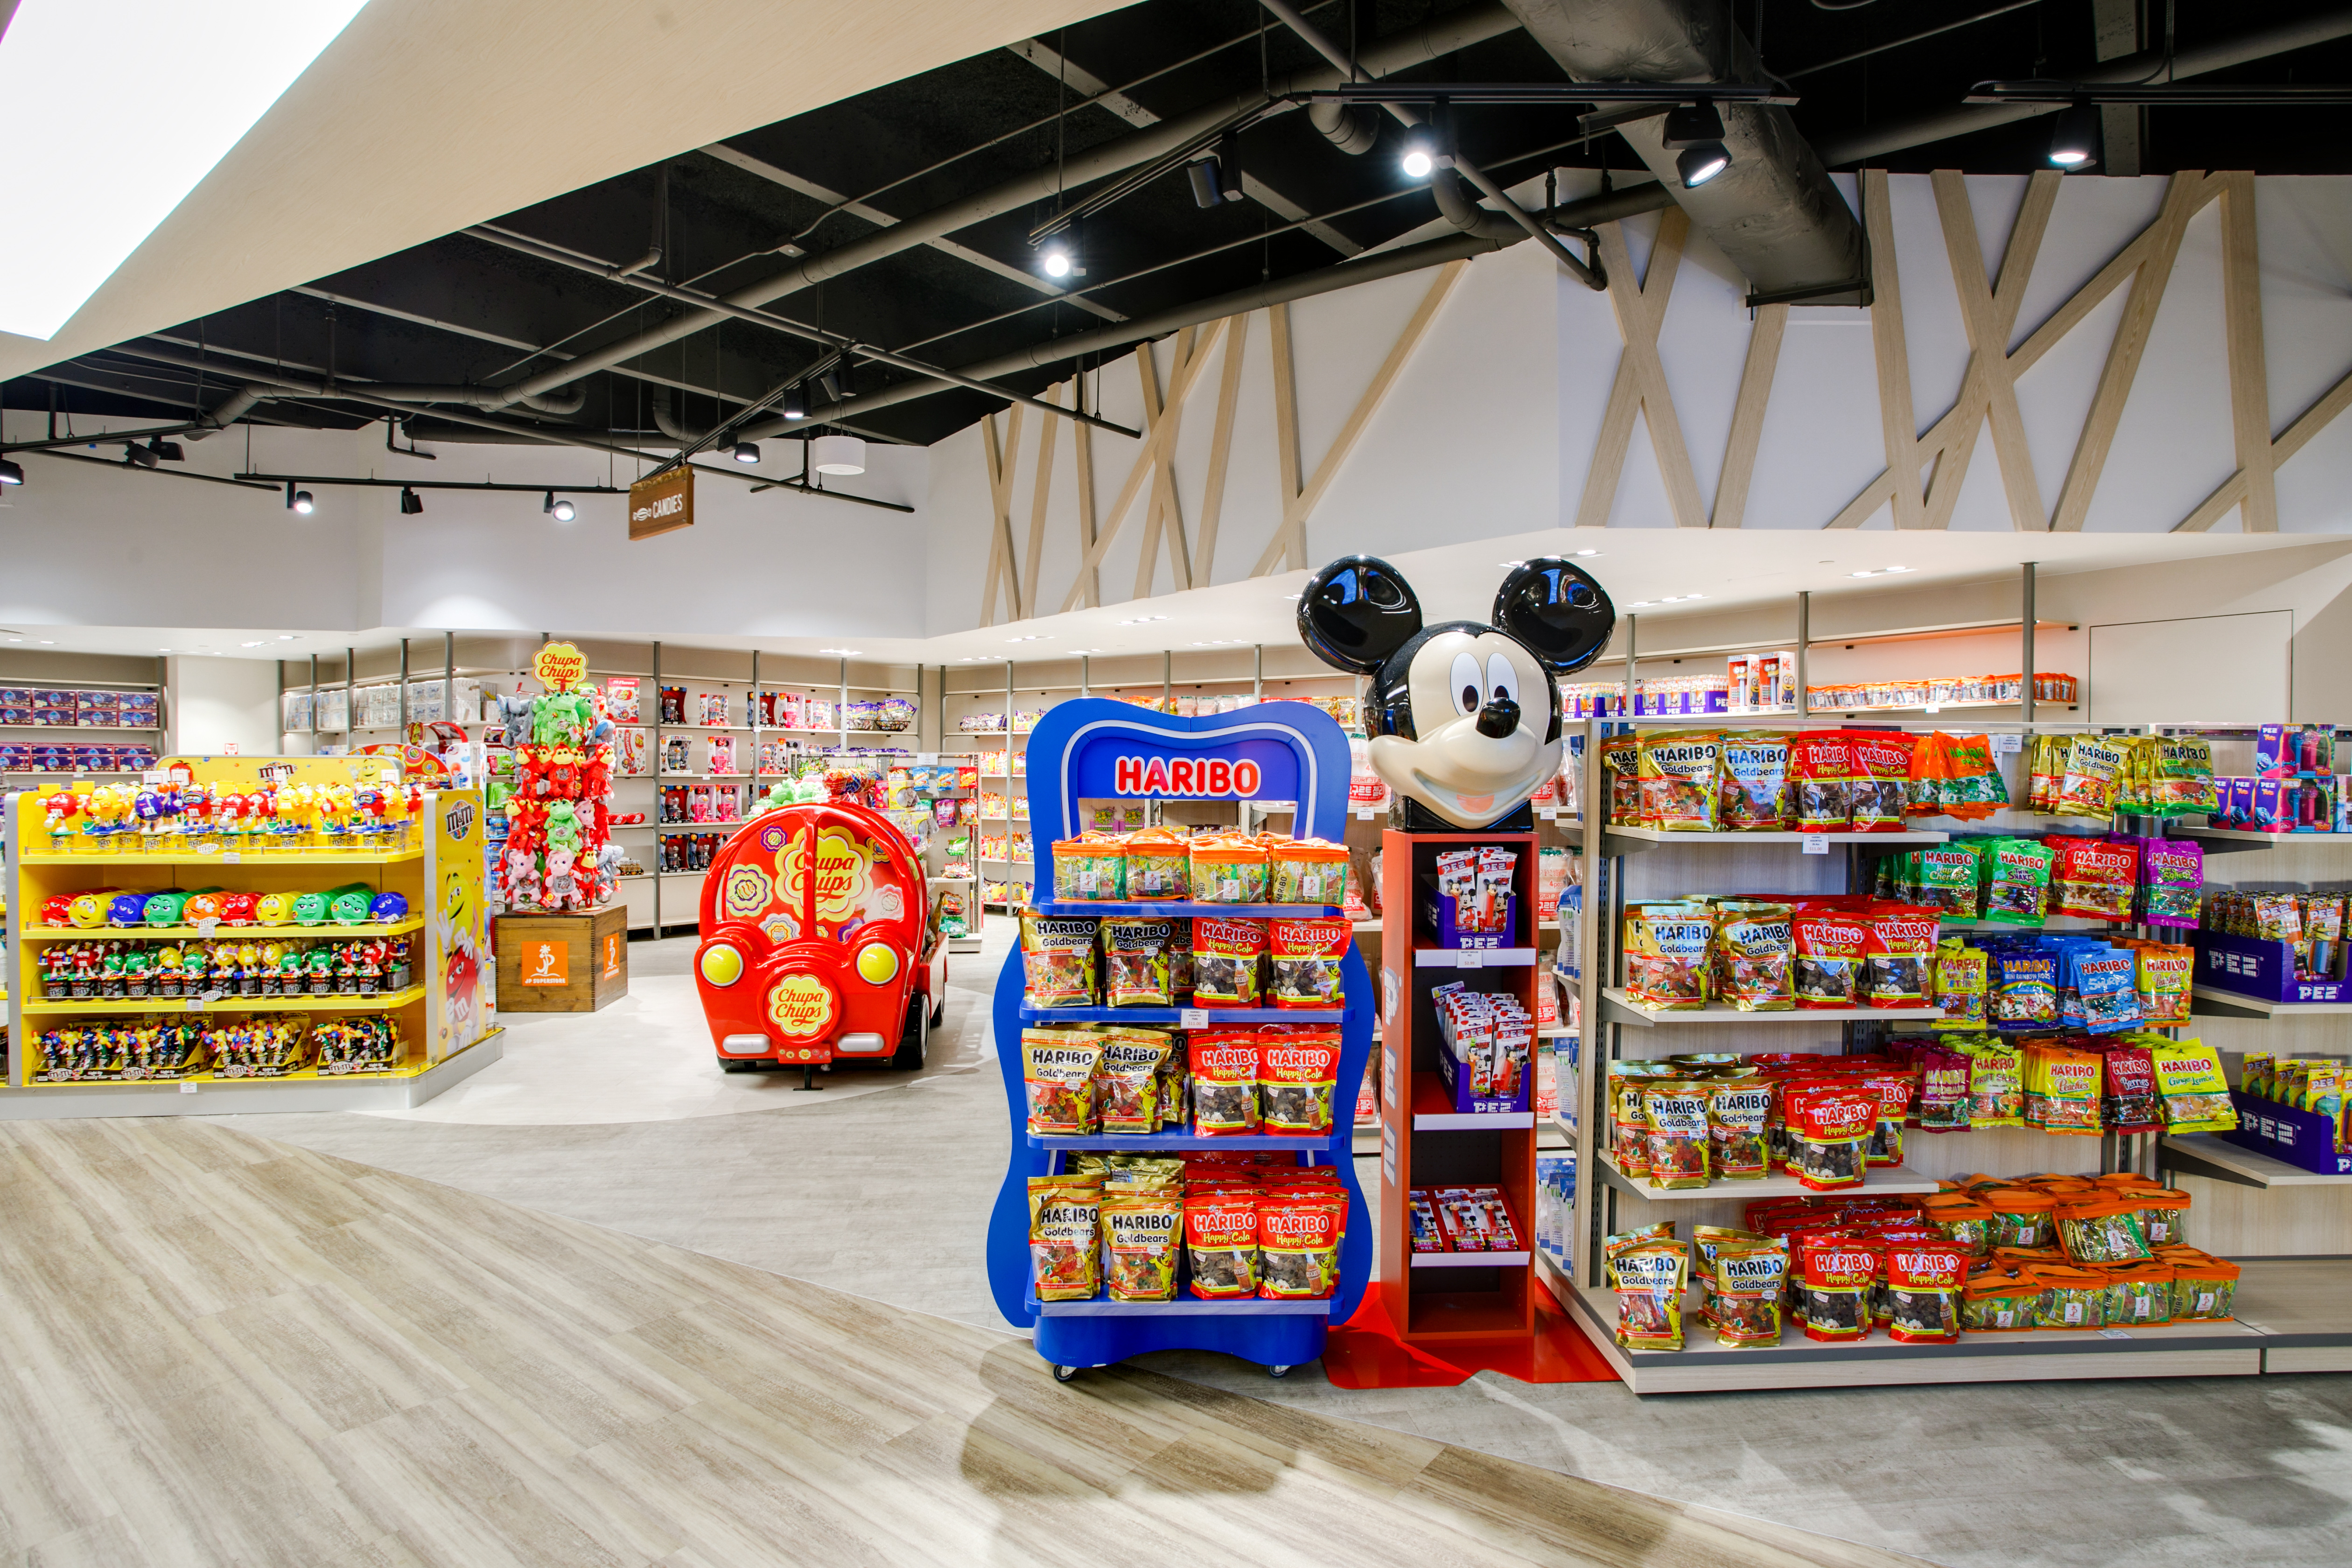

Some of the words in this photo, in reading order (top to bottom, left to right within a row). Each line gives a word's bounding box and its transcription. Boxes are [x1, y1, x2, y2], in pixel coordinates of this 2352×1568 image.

[652, 493, 683, 518] CANDIES
[542, 653, 581, 668] Chupa
[1782, 660, 1791, 670] ME
[539, 665, 580, 685] Chups
[1653, 744, 1717, 762] HARIBO
[1726, 748, 1788, 765] HARIBO
[1857, 746, 1908, 765] HARIBO
[2077, 743, 2120, 764] HARIBO
[1661, 764, 1714, 773] Goldbears
[1733, 767, 1785, 777] Goldbears
[2079, 758, 2116, 774] Goldbears
[1115, 756, 1261, 797] HARIBO
[794, 852, 856, 875] Cupa
[1925, 851, 1973, 866] HARIBO
[1999, 852, 2045, 870] HARIBO
[2073, 851, 2131, 868] HARIBO
[2151, 852, 2198, 870] HARIBO
[1483, 862, 1506, 872] PEZ
[2076, 865, 2103, 877] Happy
[2106, 868, 2126, 878] Cola
[791, 872, 853, 903] Cups
[2259, 902, 2292, 919] PEZ
[2309, 907, 2336, 920] PEZ
[1036, 921, 1097, 935] HARIBO
[1111, 924, 1170, 939] HARIBO
[1201, 922, 1261, 943] HARIBO
[1280, 926, 1340, 942] HARIBO
[1654, 924, 1712, 942] HARIBO
[1802, 924, 1862, 944] HARIBO
[1875, 922, 1932, 938] HARIBO
[1043, 937, 1092, 947] Goldbears
[1116, 939, 1164, 950] Goldbears
[1460, 935, 1500, 949] PEZ
[1659, 944, 1707, 954] Goldbears
[1745, 943, 1789, 956] Goldbear
[2003, 959, 2051, 973] HARIBO
[2080, 959, 2131, 974] HARIBO
[2209, 948, 2260, 977] PEZ
[778, 988, 824, 1006] Chupa
[2298, 984, 2339, 1000] PEZ
[776, 1003, 822, 1027] Chups
[1032, 1049, 1093, 1067] HARIBO
[1267, 1049, 1330, 1067] HARIBO
[2161, 1058, 2214, 1074] HARIBO
[1036, 1067, 1087, 1079] Goldbears
[1104, 1062, 1153, 1072] Goldbears
[2050, 1064, 2096, 1078] HARIBO
[1974, 1073, 1993, 1086] FRUIT
[2054, 1078, 2090, 1093] Peaches
[2120, 1077, 2149, 1091] Berries
[2311, 1077, 2335, 1089] PEZ
[1473, 1100, 1514, 1113] PEZ
[1651, 1099, 1707, 1115] HARIBO
[1714, 1093, 1772, 1110] HARIBO
[1720, 1113, 1768, 1123] Goldbears
[1814, 1103, 1870, 1125] HARIBO
[1659, 1118, 1707, 1128] Goldbears
[2242, 1109, 2296, 1146] PEZ
[1041, 1206, 1099, 1225] HARIBO
[1112, 1214, 1174, 1231] HARIBO
[1194, 1212, 1257, 1232] HARIBO
[1267, 1215, 1329, 1233] HARIBO
[1044, 1227, 1095, 1238] Goldbears
[1117, 1233, 1169, 1244] Goldbears
[1615, 1256, 1677, 1273] HARIBO
[1726, 1259, 1784, 1278] HARIBO
[1815, 1253, 1874, 1272] HARIBO
[1898, 1254, 1959, 1272] HARIBO
